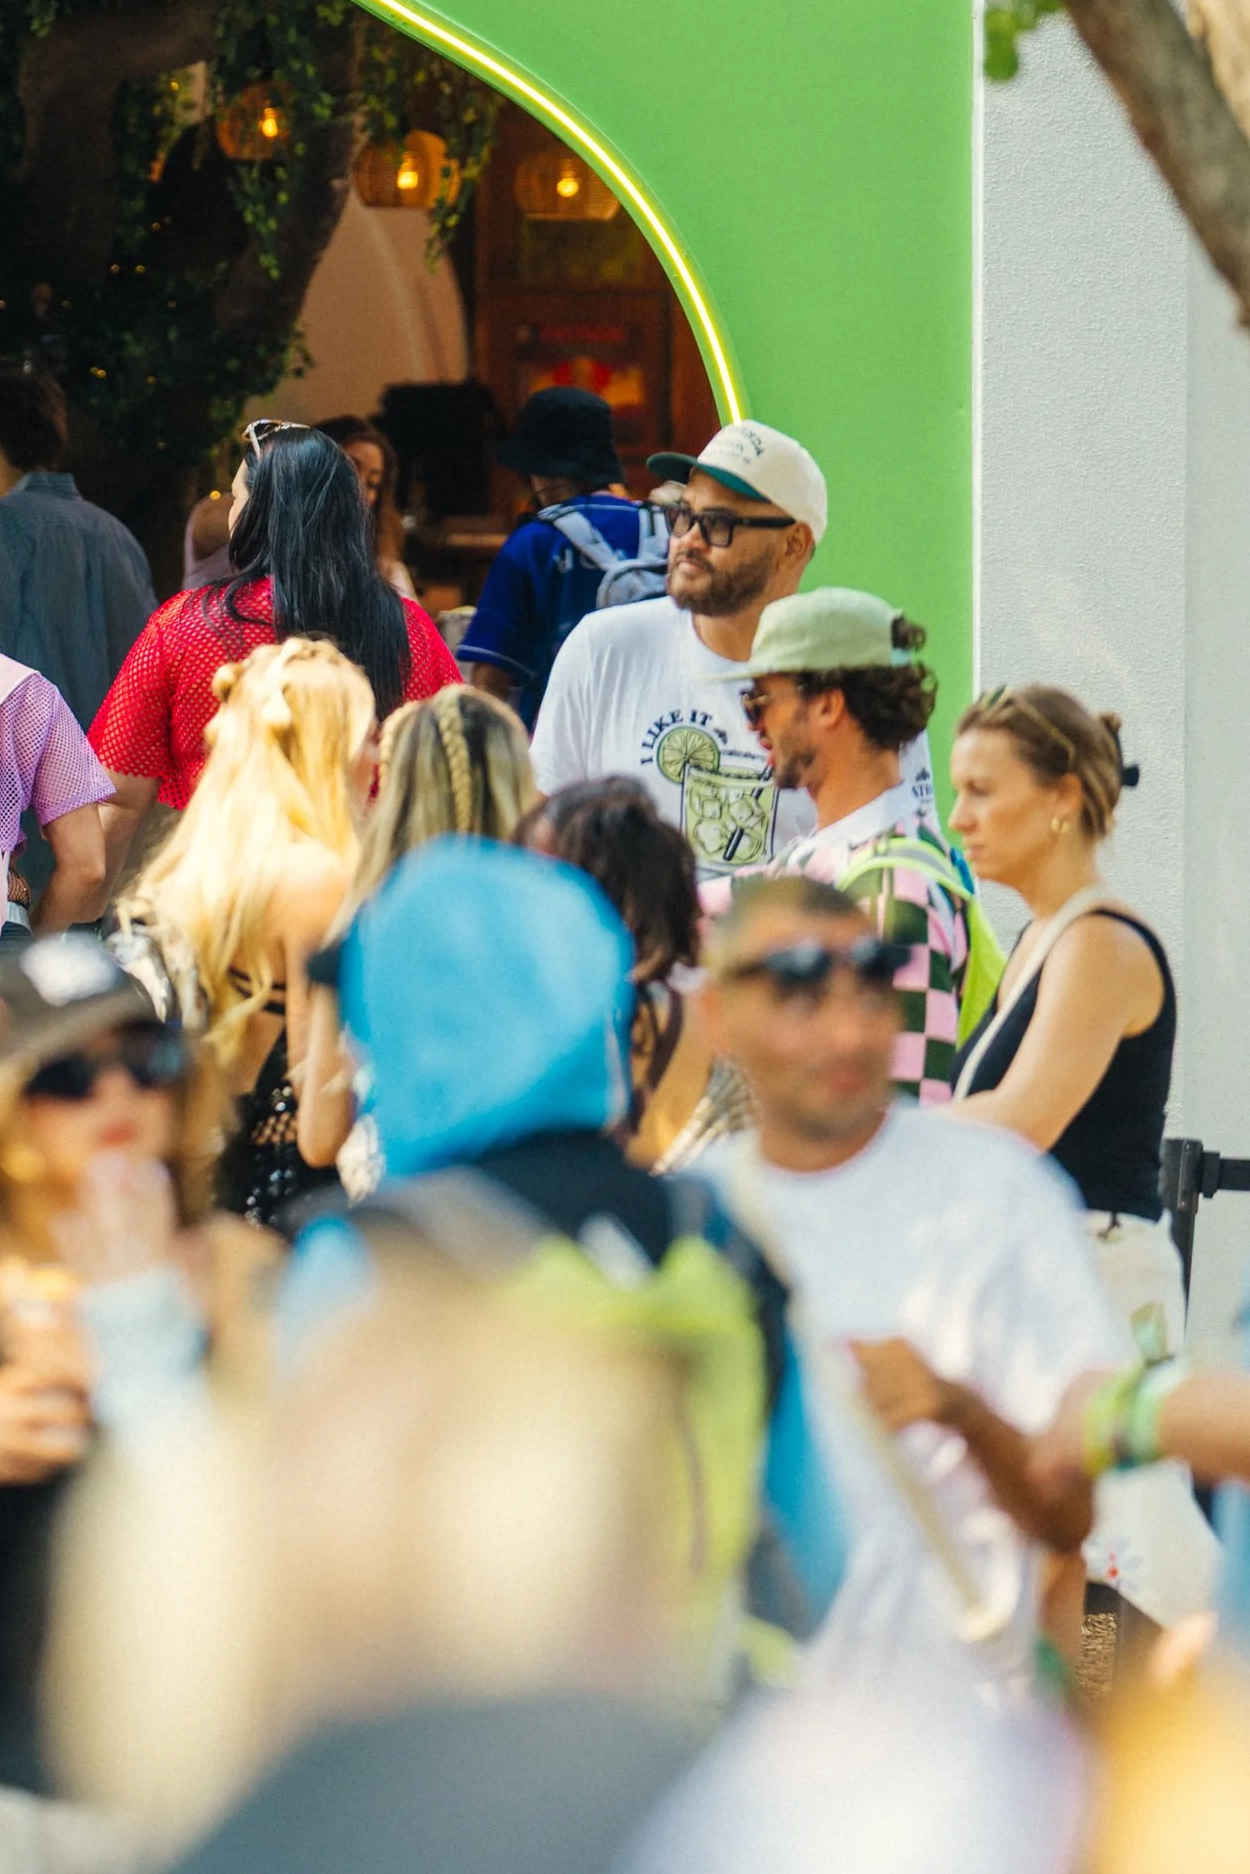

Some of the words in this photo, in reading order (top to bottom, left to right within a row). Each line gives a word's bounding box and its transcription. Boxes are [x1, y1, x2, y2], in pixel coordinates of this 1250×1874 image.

[690, 709, 713, 726] IT
[641, 709, 684, 749] LIKE
[640, 755, 654, 765] I
